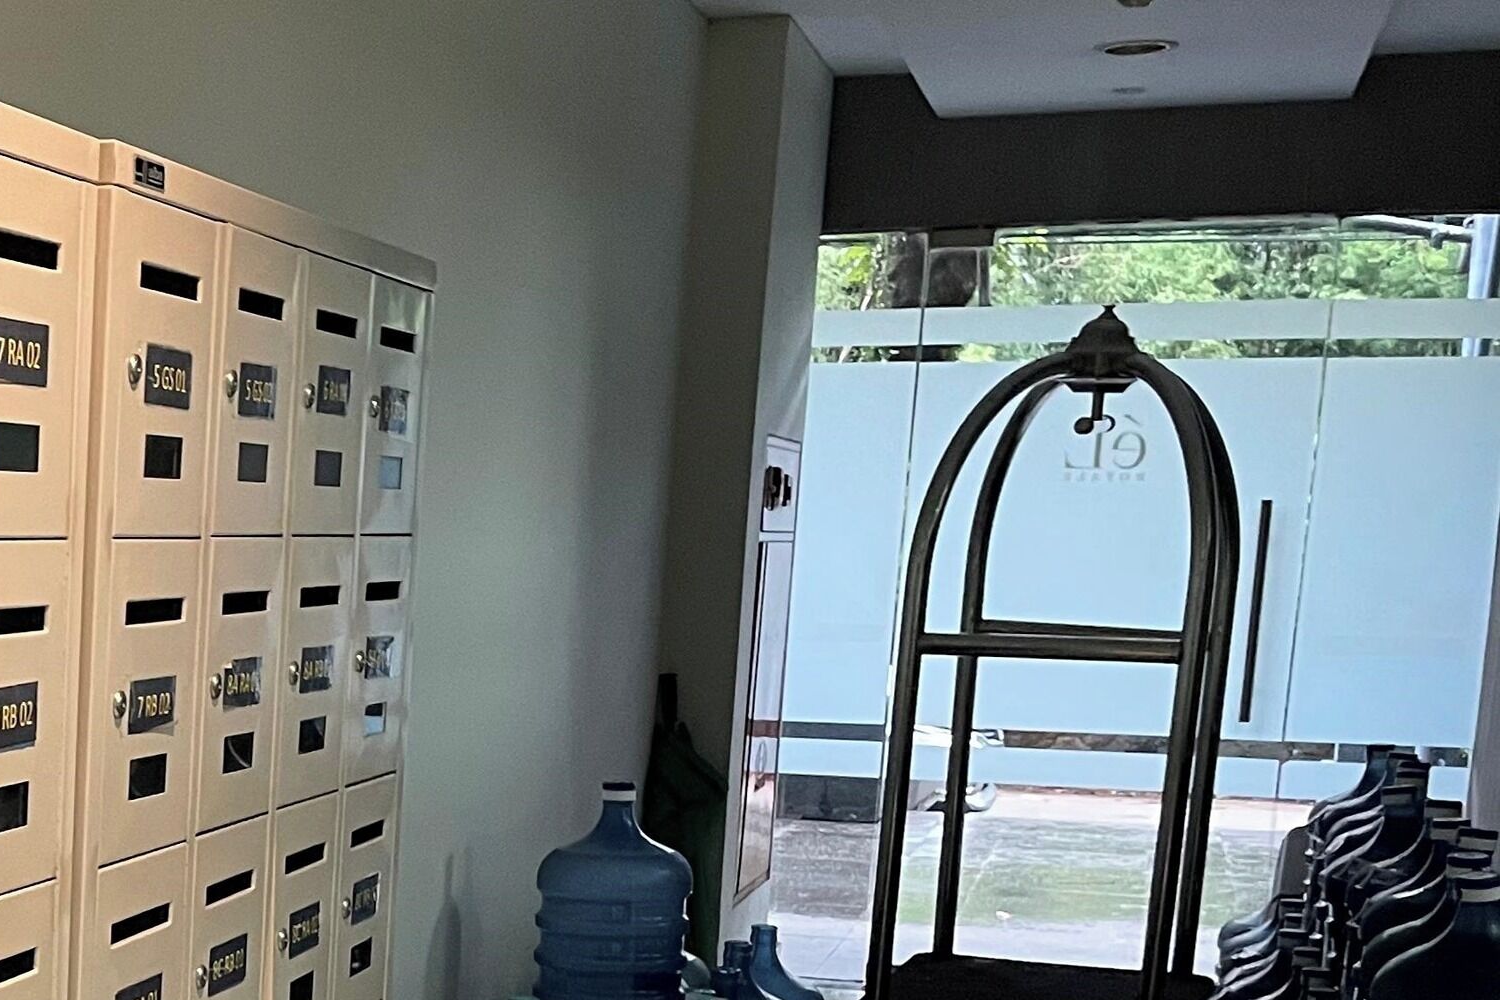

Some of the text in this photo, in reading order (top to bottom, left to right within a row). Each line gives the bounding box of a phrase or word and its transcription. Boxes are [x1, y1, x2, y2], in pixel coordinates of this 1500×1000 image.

[7, 338, 25, 367] RA
[26, 341, 41, 369] 02
[152, 364, 187, 393] 5 GS 01
[245, 379, 251, 401] 5
[1, 703, 18, 730] RB
[19, 700, 33, 727] 02
[137, 691, 171, 719] 7 RB 02
